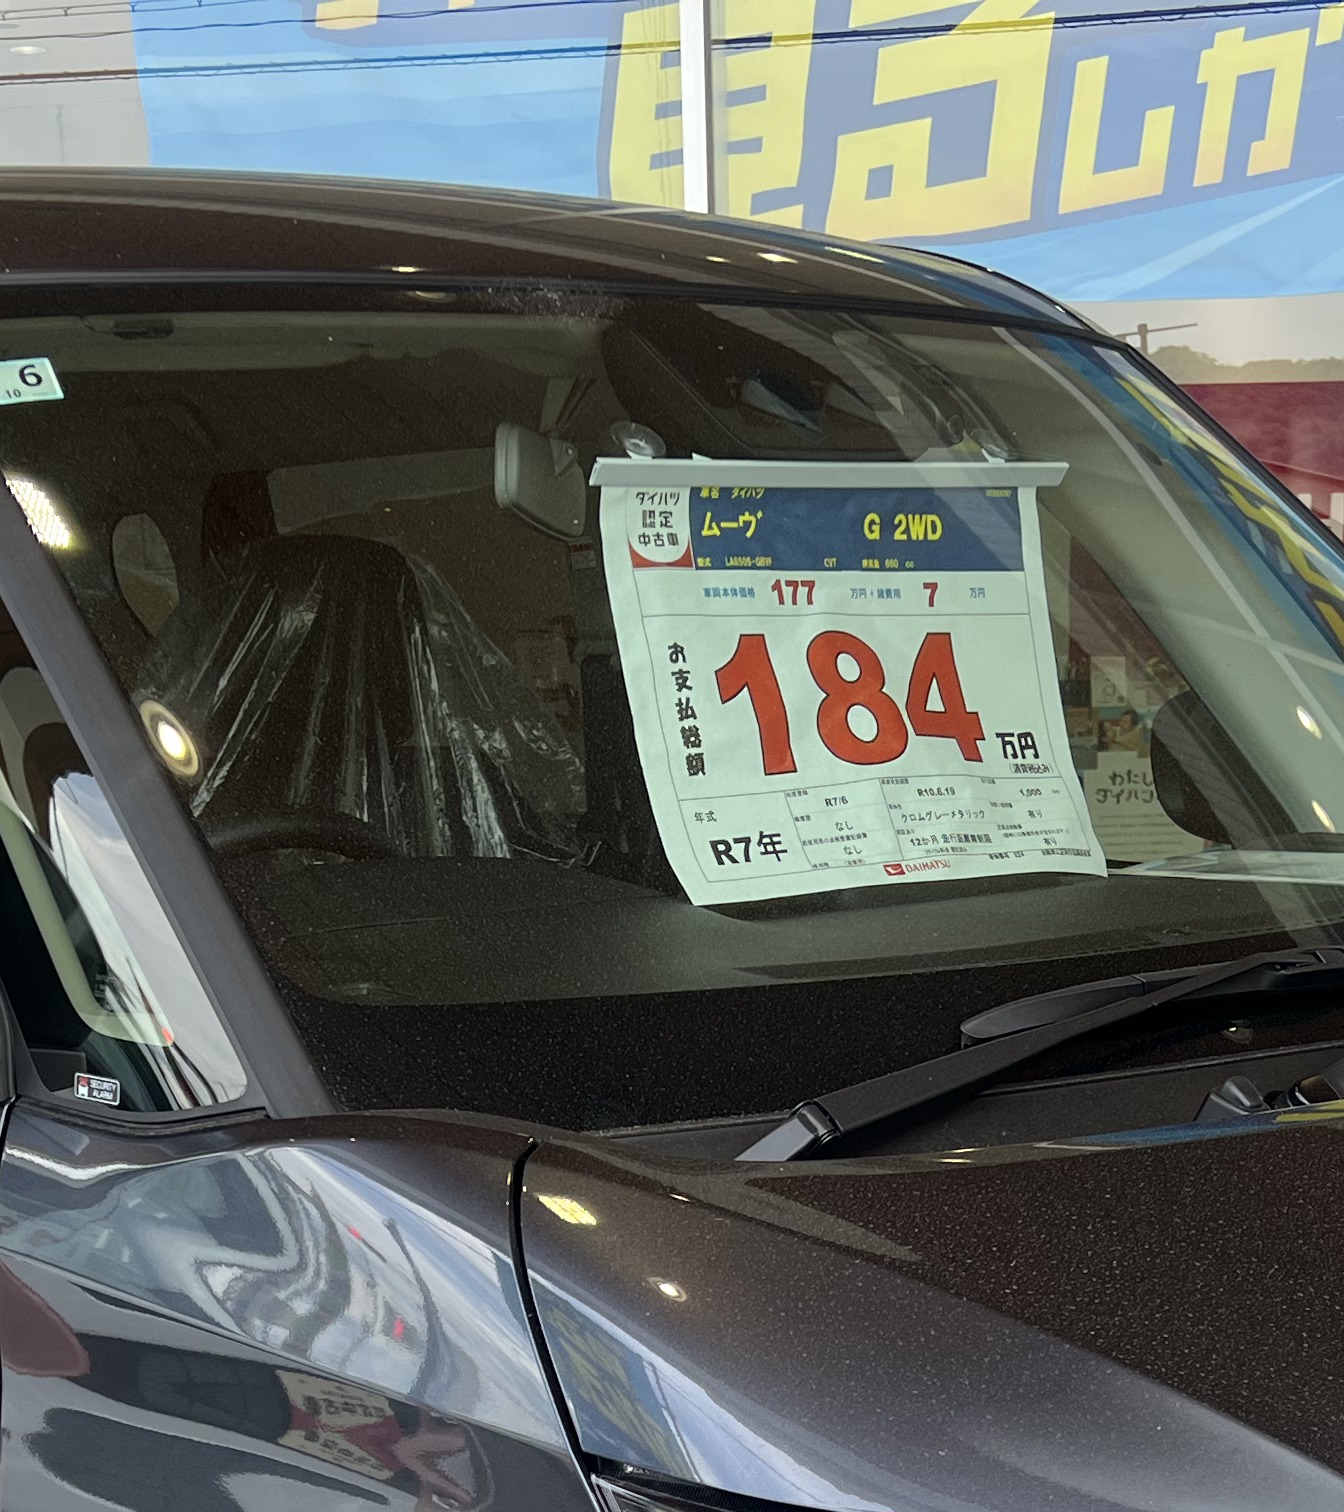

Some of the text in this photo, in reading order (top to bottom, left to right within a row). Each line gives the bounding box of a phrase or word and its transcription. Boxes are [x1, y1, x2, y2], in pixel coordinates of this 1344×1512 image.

[18, 364, 43, 387] 6
[6, 389, 22, 399] 10
[635, 491, 681, 506] ダイハツ
[642, 509, 674, 529] 認定
[701, 510, 943, 541] ムーヴ G 2WD
[637, 532, 680, 547] 中古車
[771, 578, 816, 606] 177
[923, 582, 939, 608] 7
[969, 587, 986, 599] 万円
[667, 641, 706, 777] お支払総額
[714, 629, 1040, 777] 184 万円
[693, 811, 718, 824] 年式
[901, 808, 986, 823] クロムグレーメタリック
[834, 820, 854, 831] なし
[708, 830, 789, 867] R7年
[843, 844, 863, 855] なし
[904, 859, 952, 873] DAIHATSU
